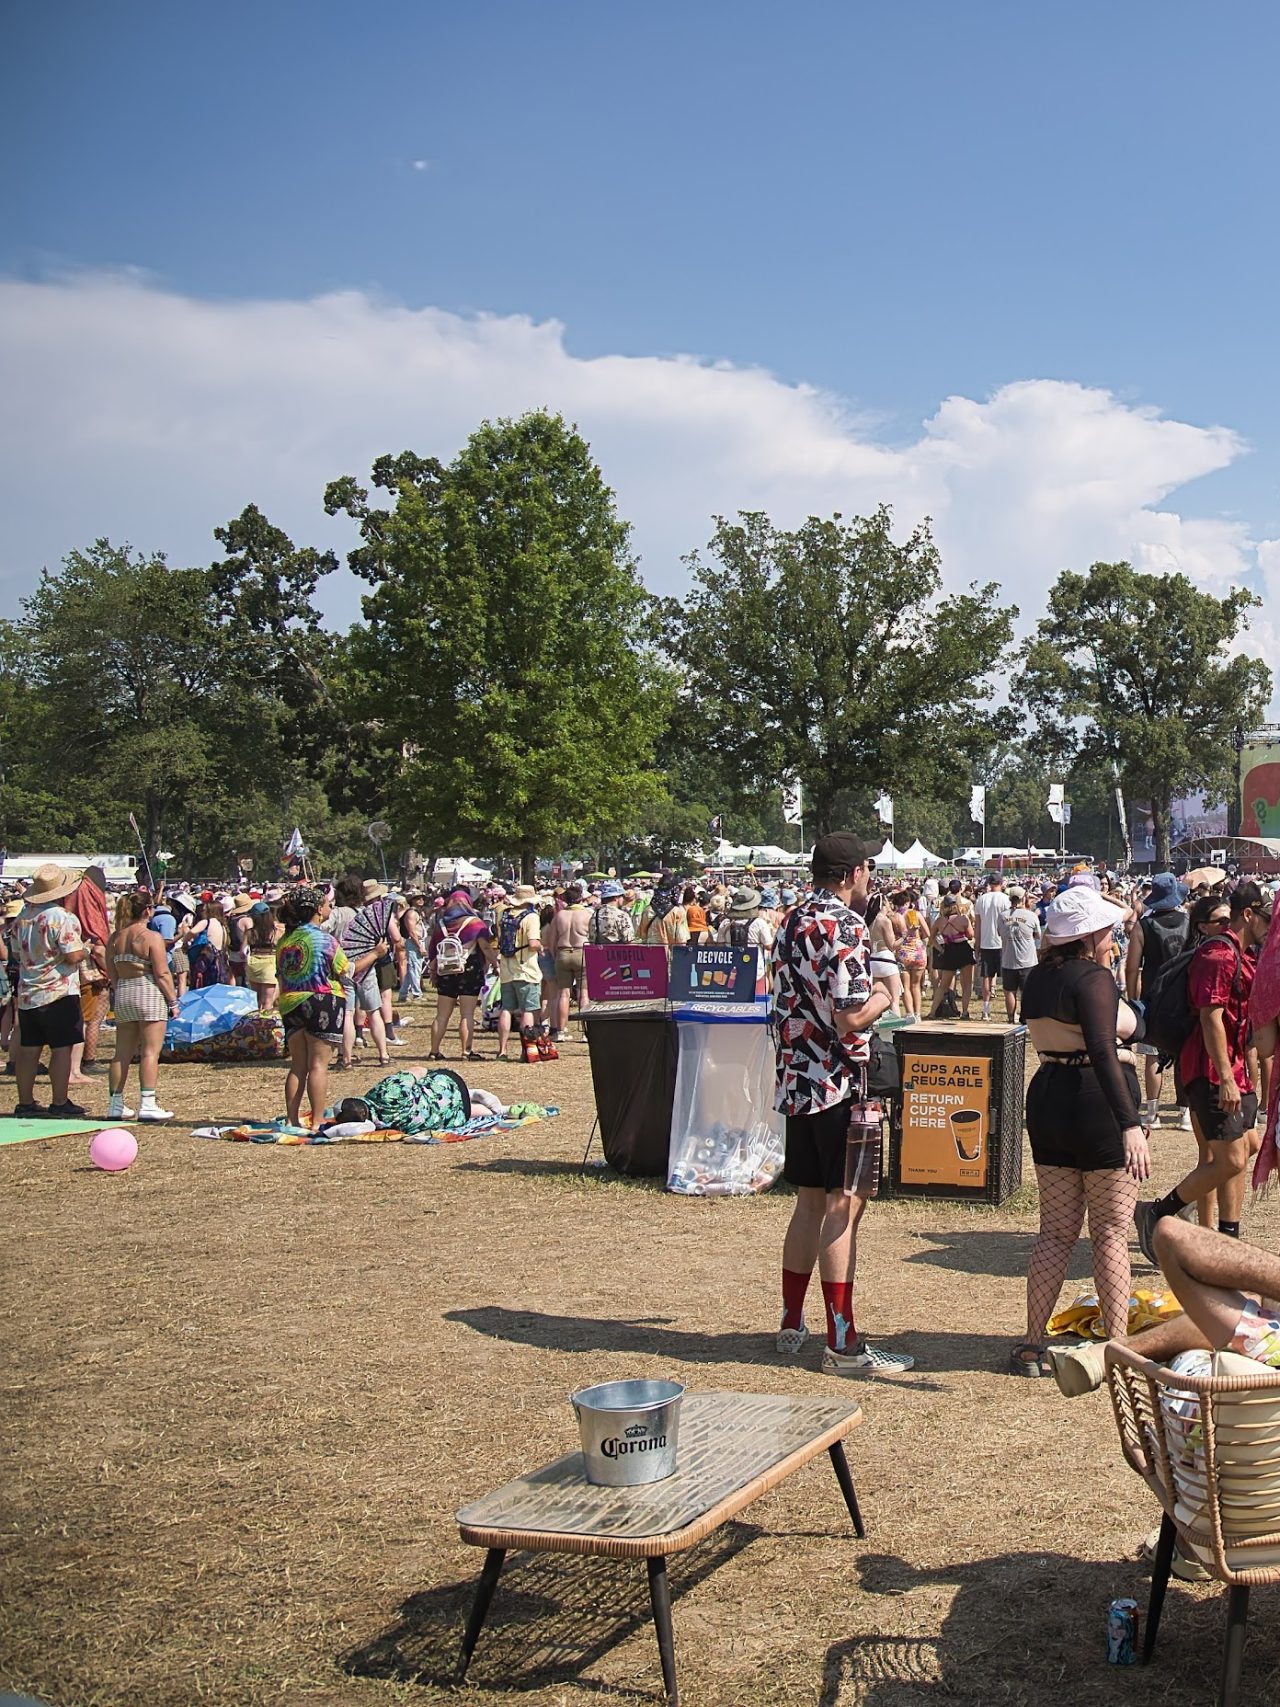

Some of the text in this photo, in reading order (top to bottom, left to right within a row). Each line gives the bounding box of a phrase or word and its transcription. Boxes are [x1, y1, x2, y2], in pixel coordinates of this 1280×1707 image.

[697, 951, 733, 964] RECYCLE
[690, 1003, 761, 1013] RECYCLABLES
[911, 1063, 981, 1076] CUPS ARE
[911, 1075, 983, 1088] REUSABLE
[910, 1093, 964, 1105] RETURN
[910, 1105, 946, 1117] CUPS
[909, 1117, 946, 1128] HERE
[600, 1435, 667, 1460] Corona
